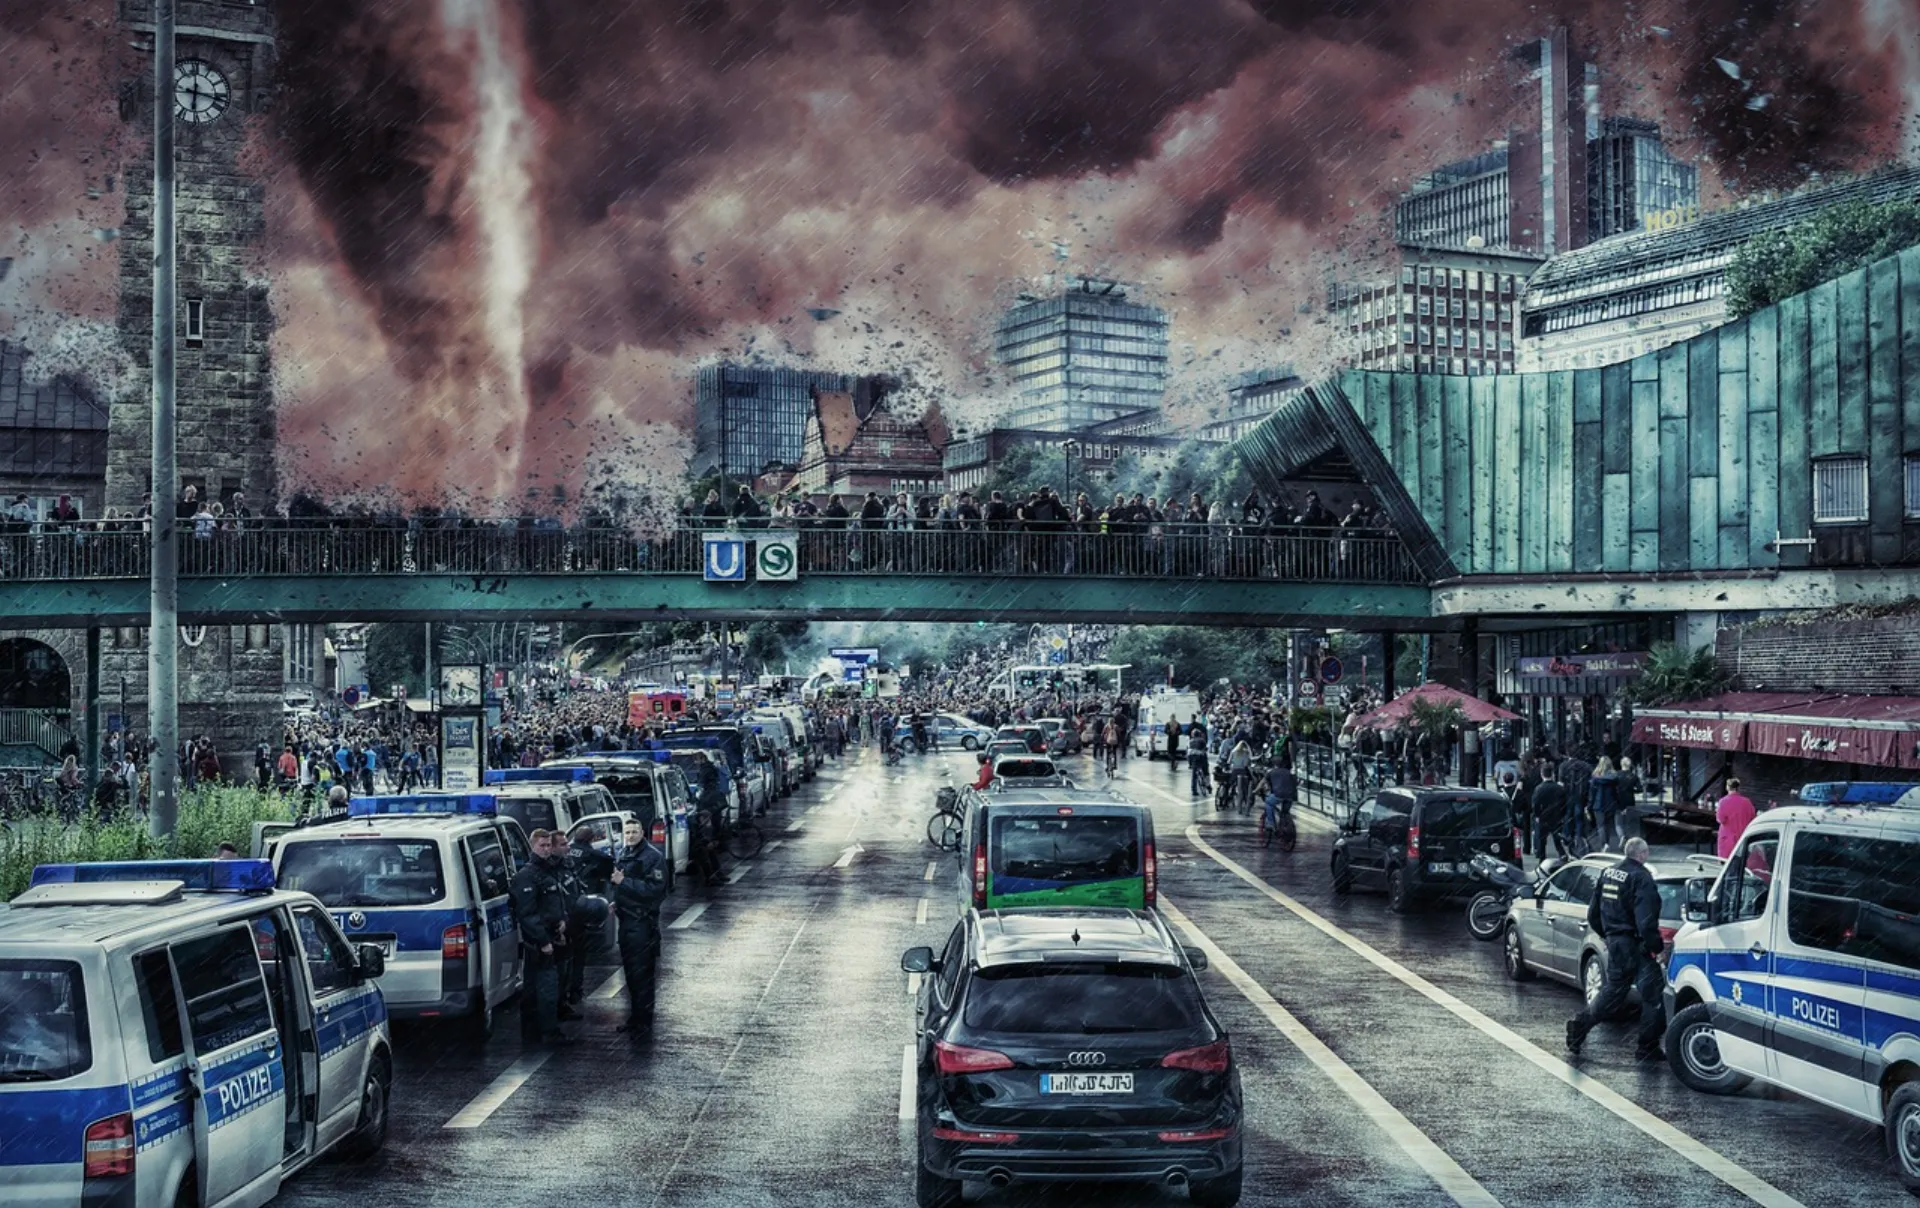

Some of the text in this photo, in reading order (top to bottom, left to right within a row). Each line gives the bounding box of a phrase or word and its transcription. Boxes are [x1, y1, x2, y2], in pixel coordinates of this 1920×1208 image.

[1645, 206, 1698, 232] HOTE
[711, 544, 739, 577] U
[765, 545, 789, 574] S
[1792, 997, 1840, 1029] POLIZEI
[218, 1064, 273, 1116] POLIZEI
